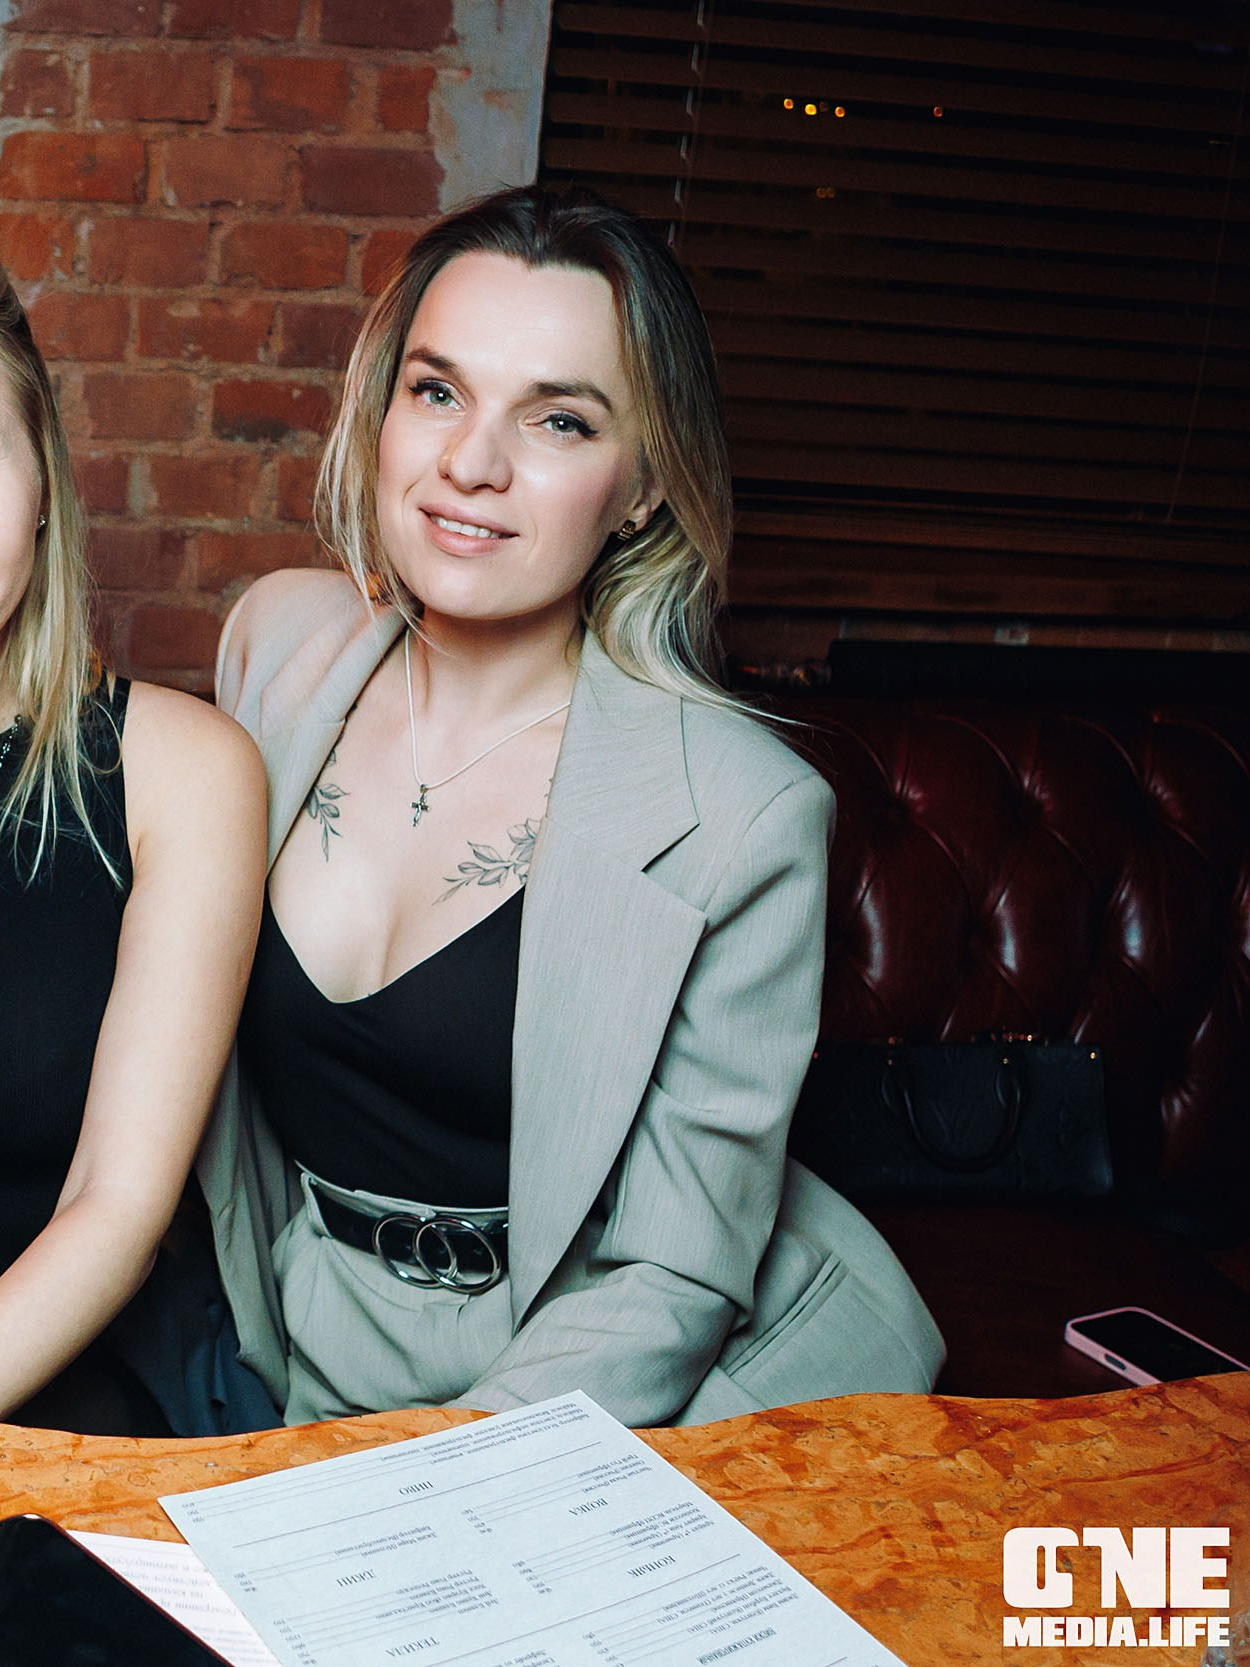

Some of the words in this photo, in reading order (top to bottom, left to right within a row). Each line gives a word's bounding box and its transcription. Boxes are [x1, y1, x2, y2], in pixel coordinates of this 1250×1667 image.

[399, 1481, 433, 1496] ПИВО
[569, 1497, 608, 1517] ВОДКА
[627, 1556, 676, 1578] КОНЬЯК
[336, 1569, 376, 1588] ДЖИН
[385, 1637, 439, 1657] ТЕКИЛА
